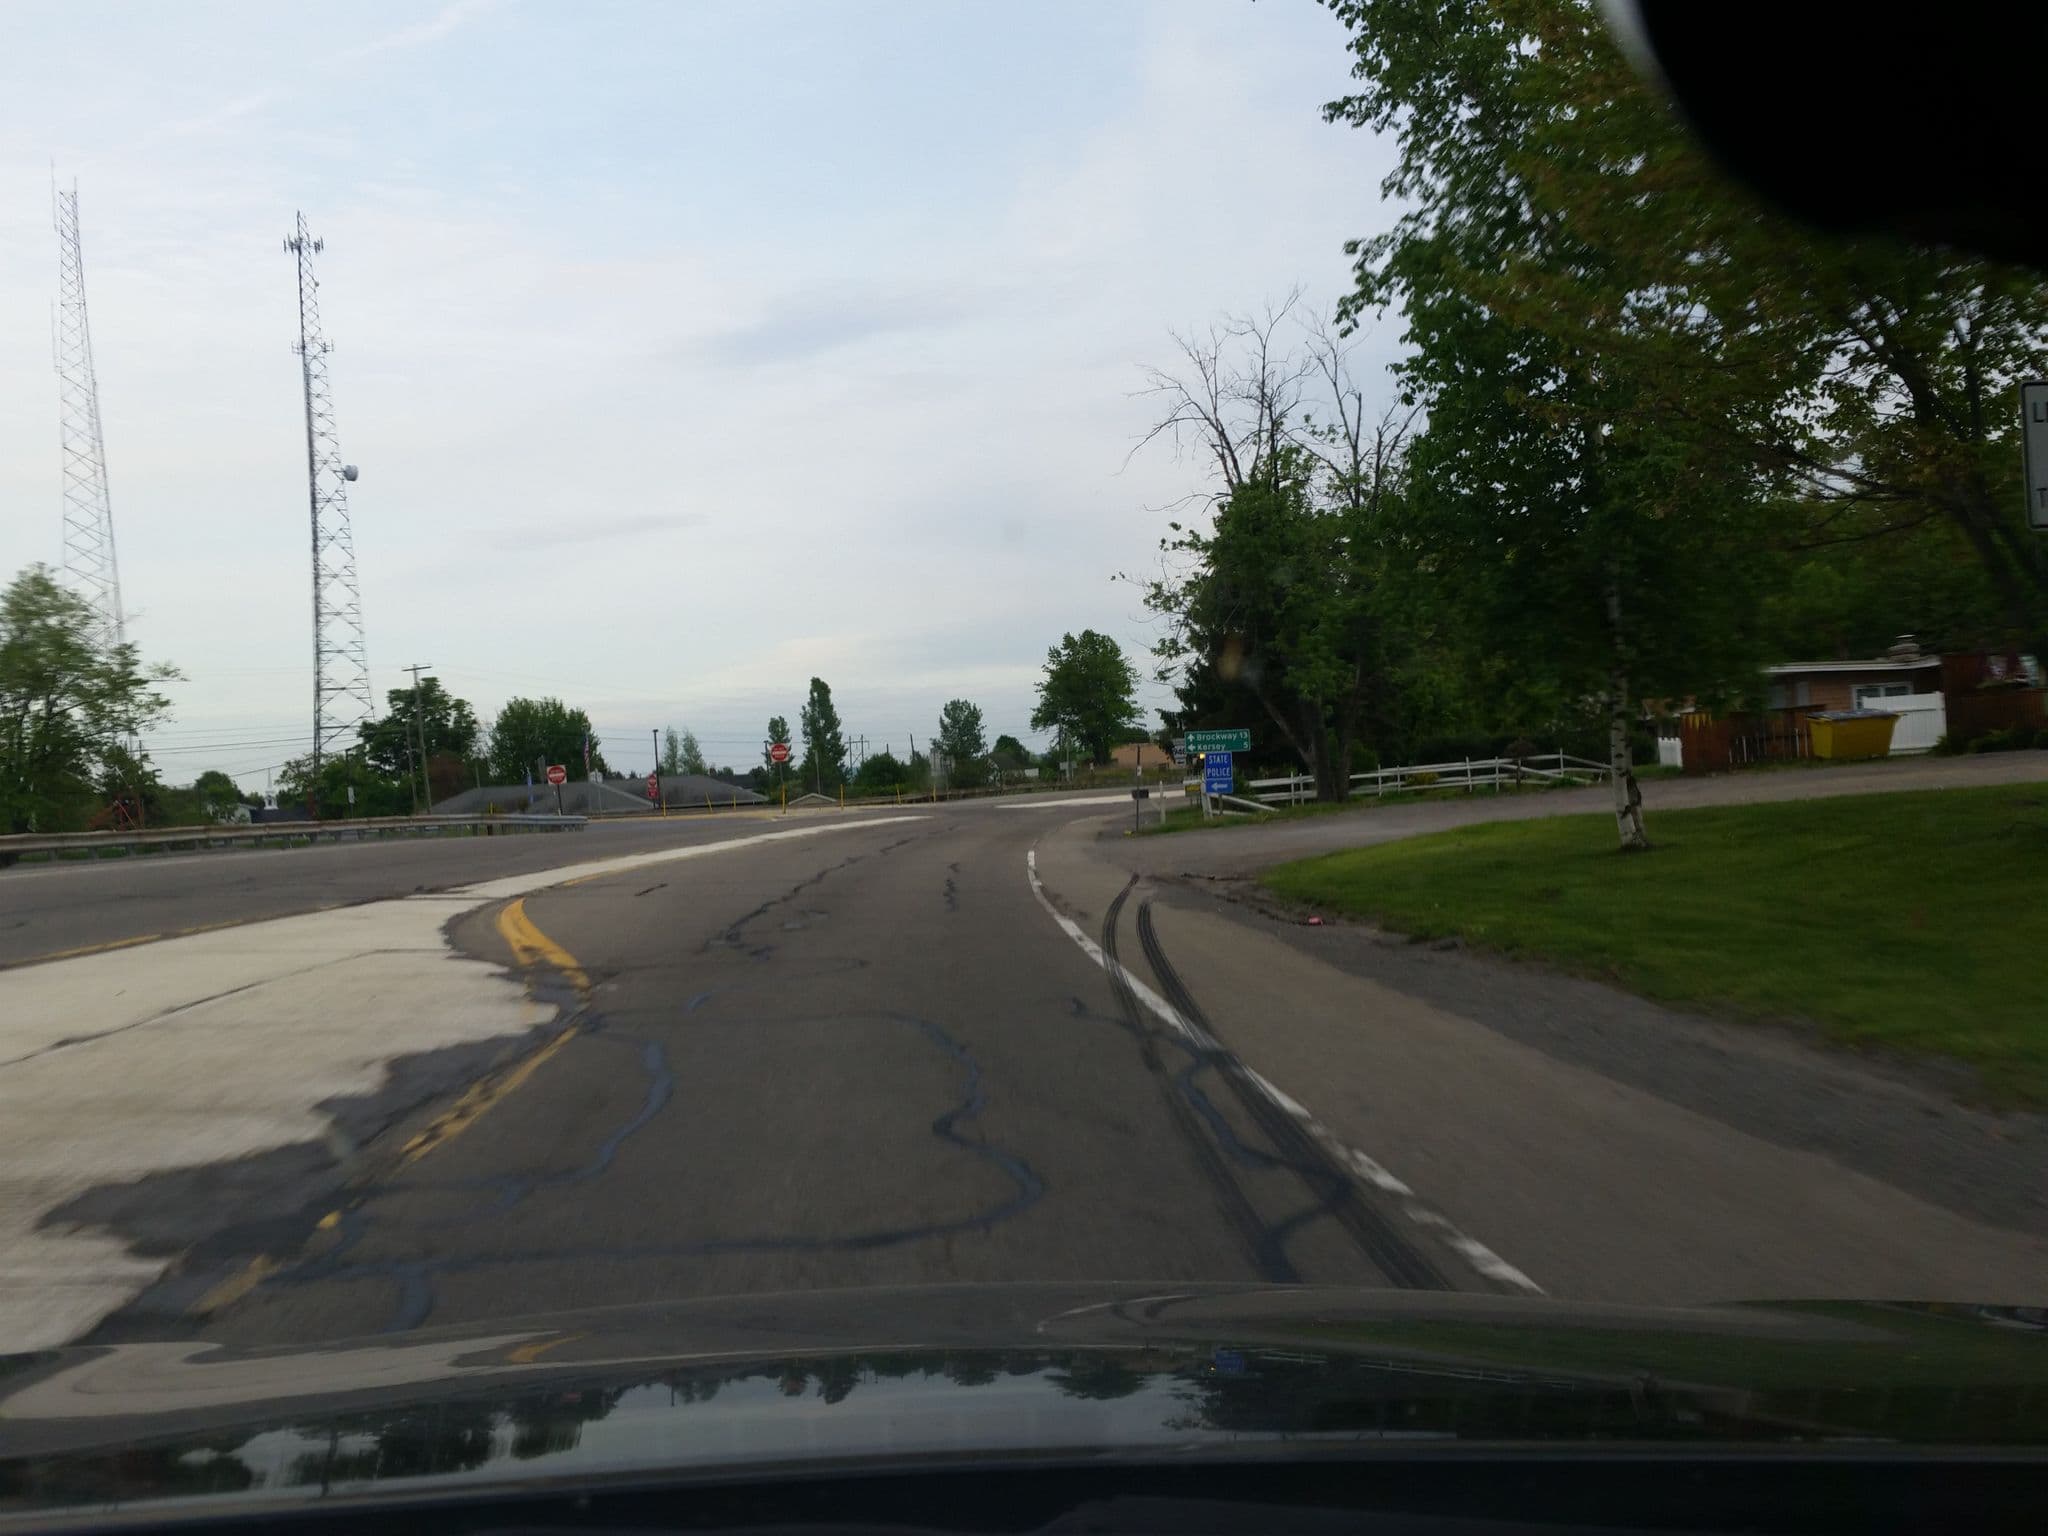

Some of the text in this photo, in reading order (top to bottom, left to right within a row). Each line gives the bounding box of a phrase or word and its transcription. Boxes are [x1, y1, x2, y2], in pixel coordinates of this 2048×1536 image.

[1196, 731, 1248, 741] Brockway 13
[1208, 755, 1228, 764] STATE
[1207, 767, 1231, 777] POLICE
